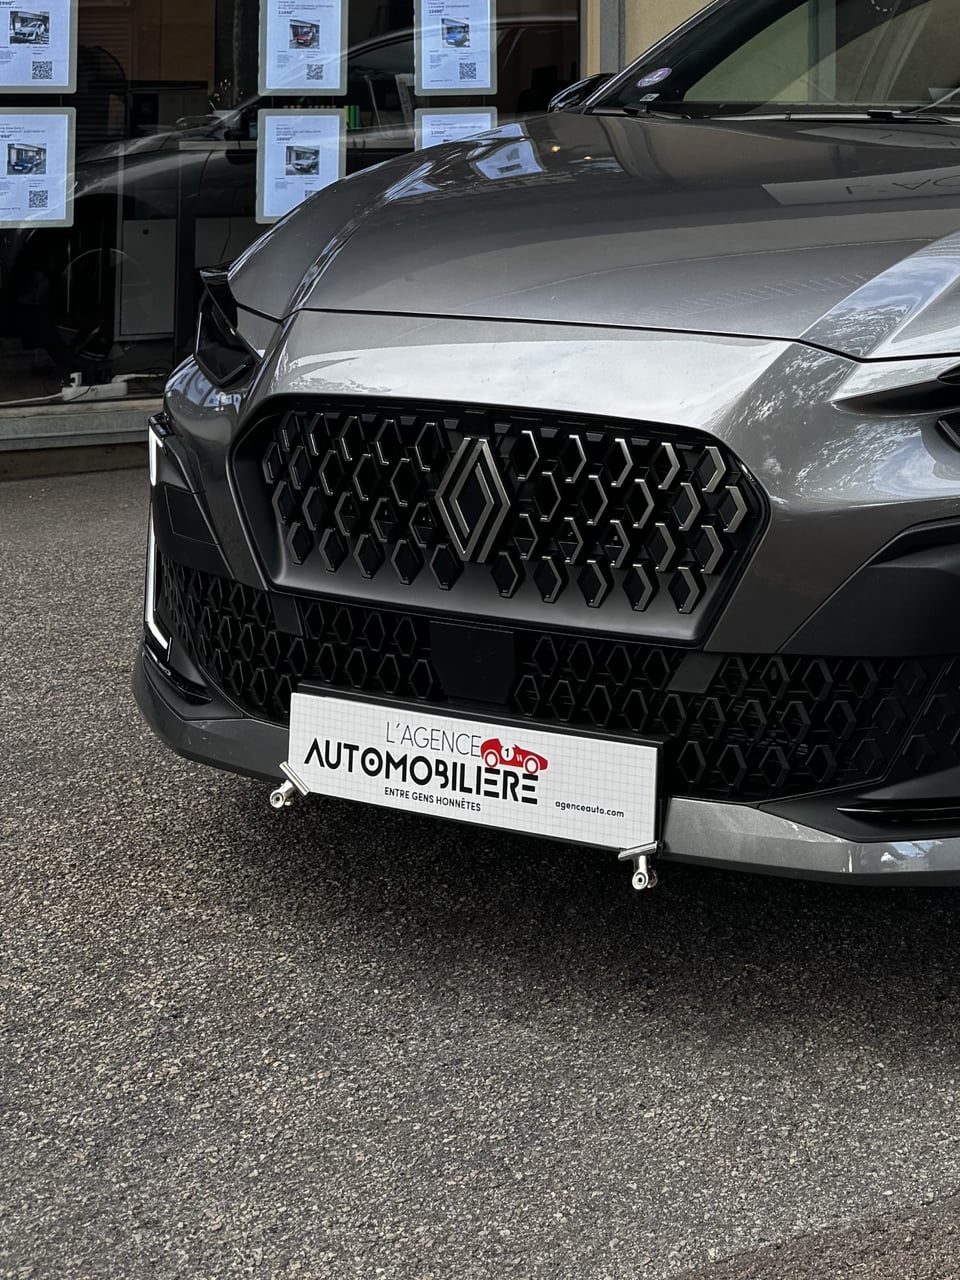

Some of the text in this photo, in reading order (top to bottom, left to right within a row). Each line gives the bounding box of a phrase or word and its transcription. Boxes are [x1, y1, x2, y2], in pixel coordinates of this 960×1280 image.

[386, 721, 482, 758] L'AGENCE
[303, 737, 539, 805] AUTOMOBILIERE
[384, 786, 481, 812] ENTRE GENS HONNÊTES
[554, 800, 625, 819] agenceauto.com
